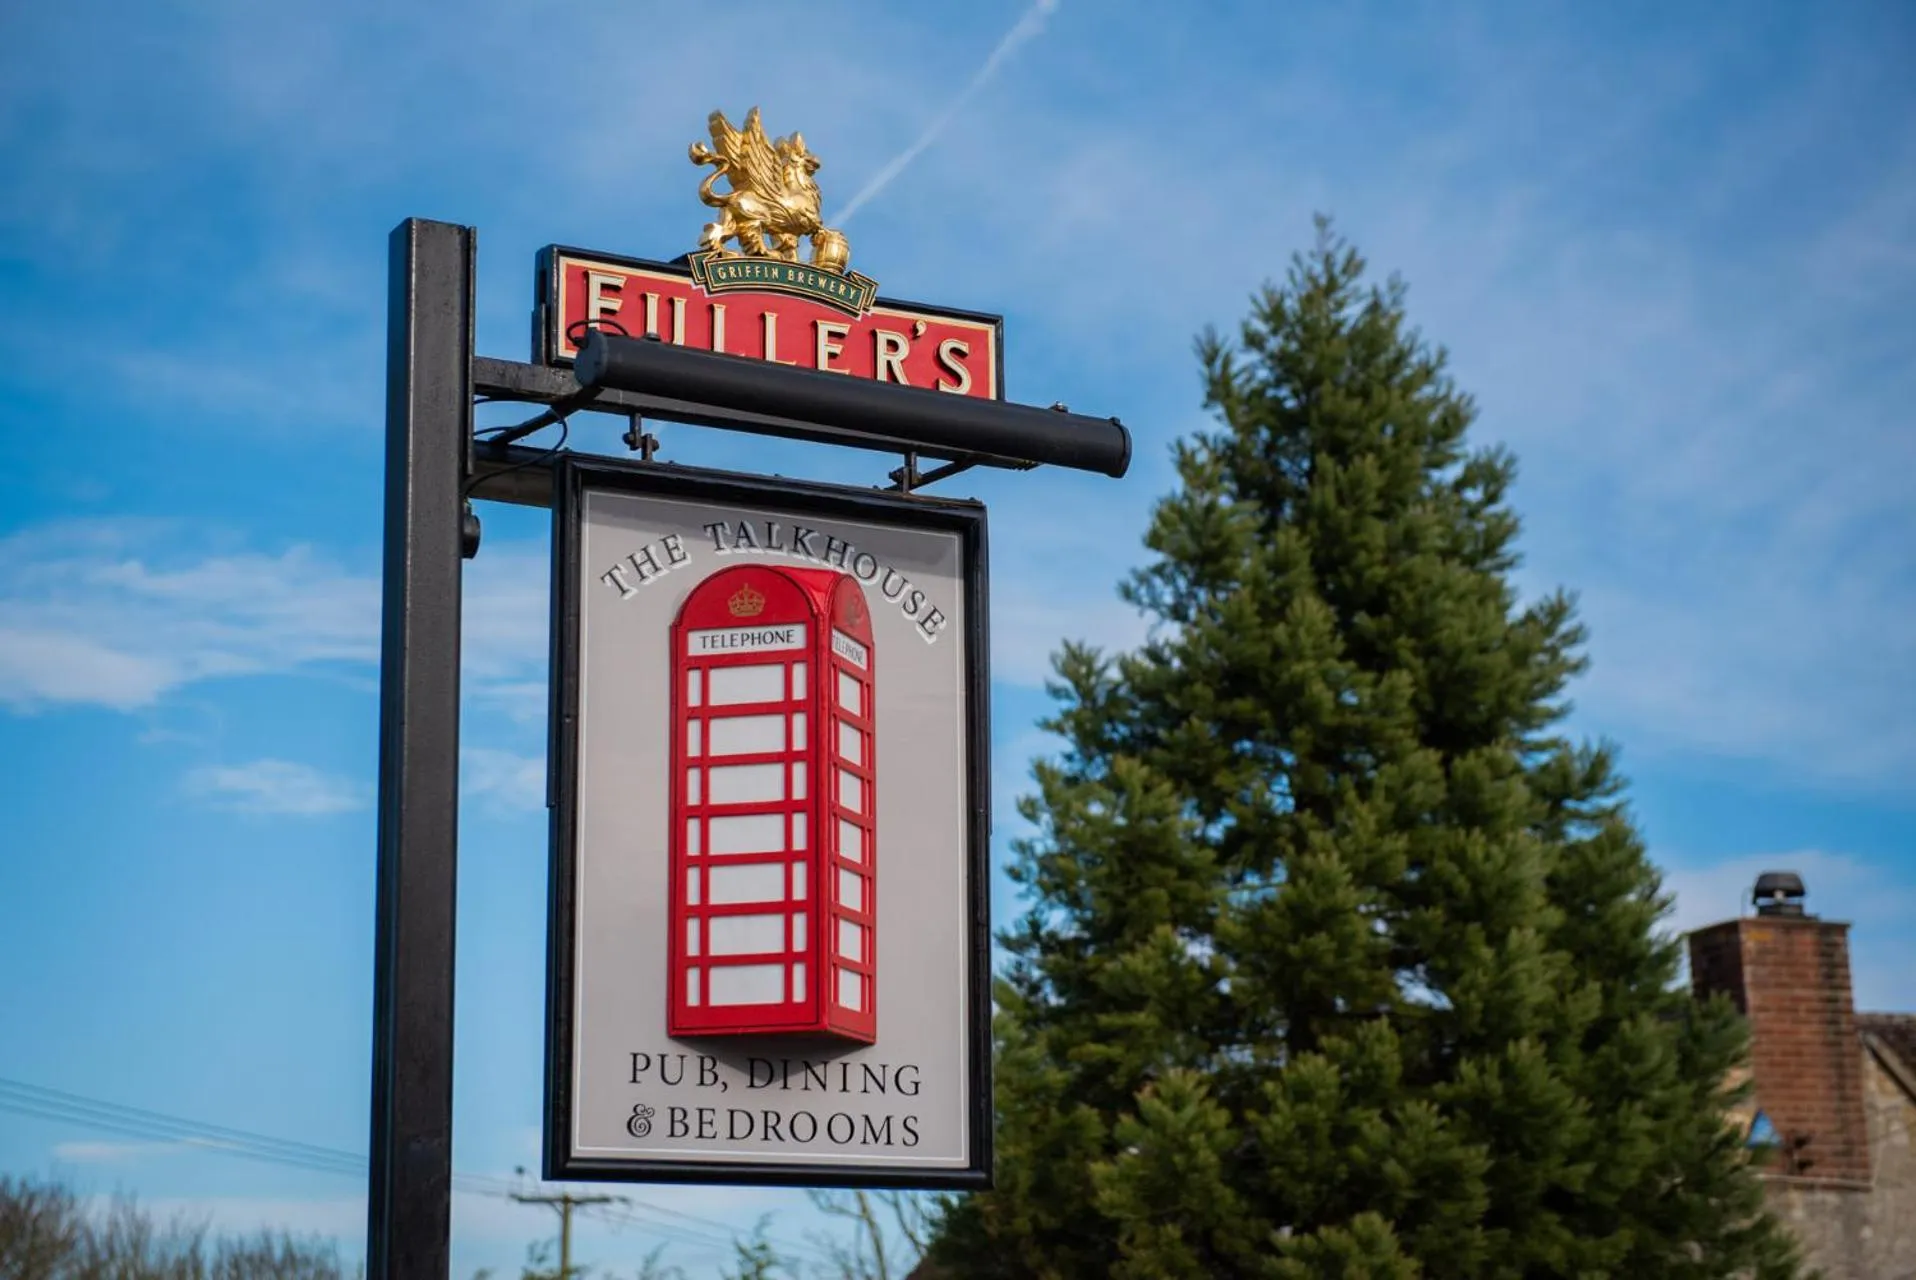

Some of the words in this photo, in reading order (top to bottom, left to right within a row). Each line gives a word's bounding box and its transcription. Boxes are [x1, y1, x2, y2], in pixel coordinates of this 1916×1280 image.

[718, 265, 780, 280] GRIFFIN
[788, 269, 858, 301] BREWERY
[600, 533, 689, 598] THE
[704, 520, 945, 637] TALKHOUSE
[700, 629, 796, 650] TELEPHONE
[628, 1052, 729, 1093] PUB,
[747, 1057, 922, 1096] DINING
[626, 1103, 656, 1138] &
[666, 1106, 920, 1147] BEDROOMS
